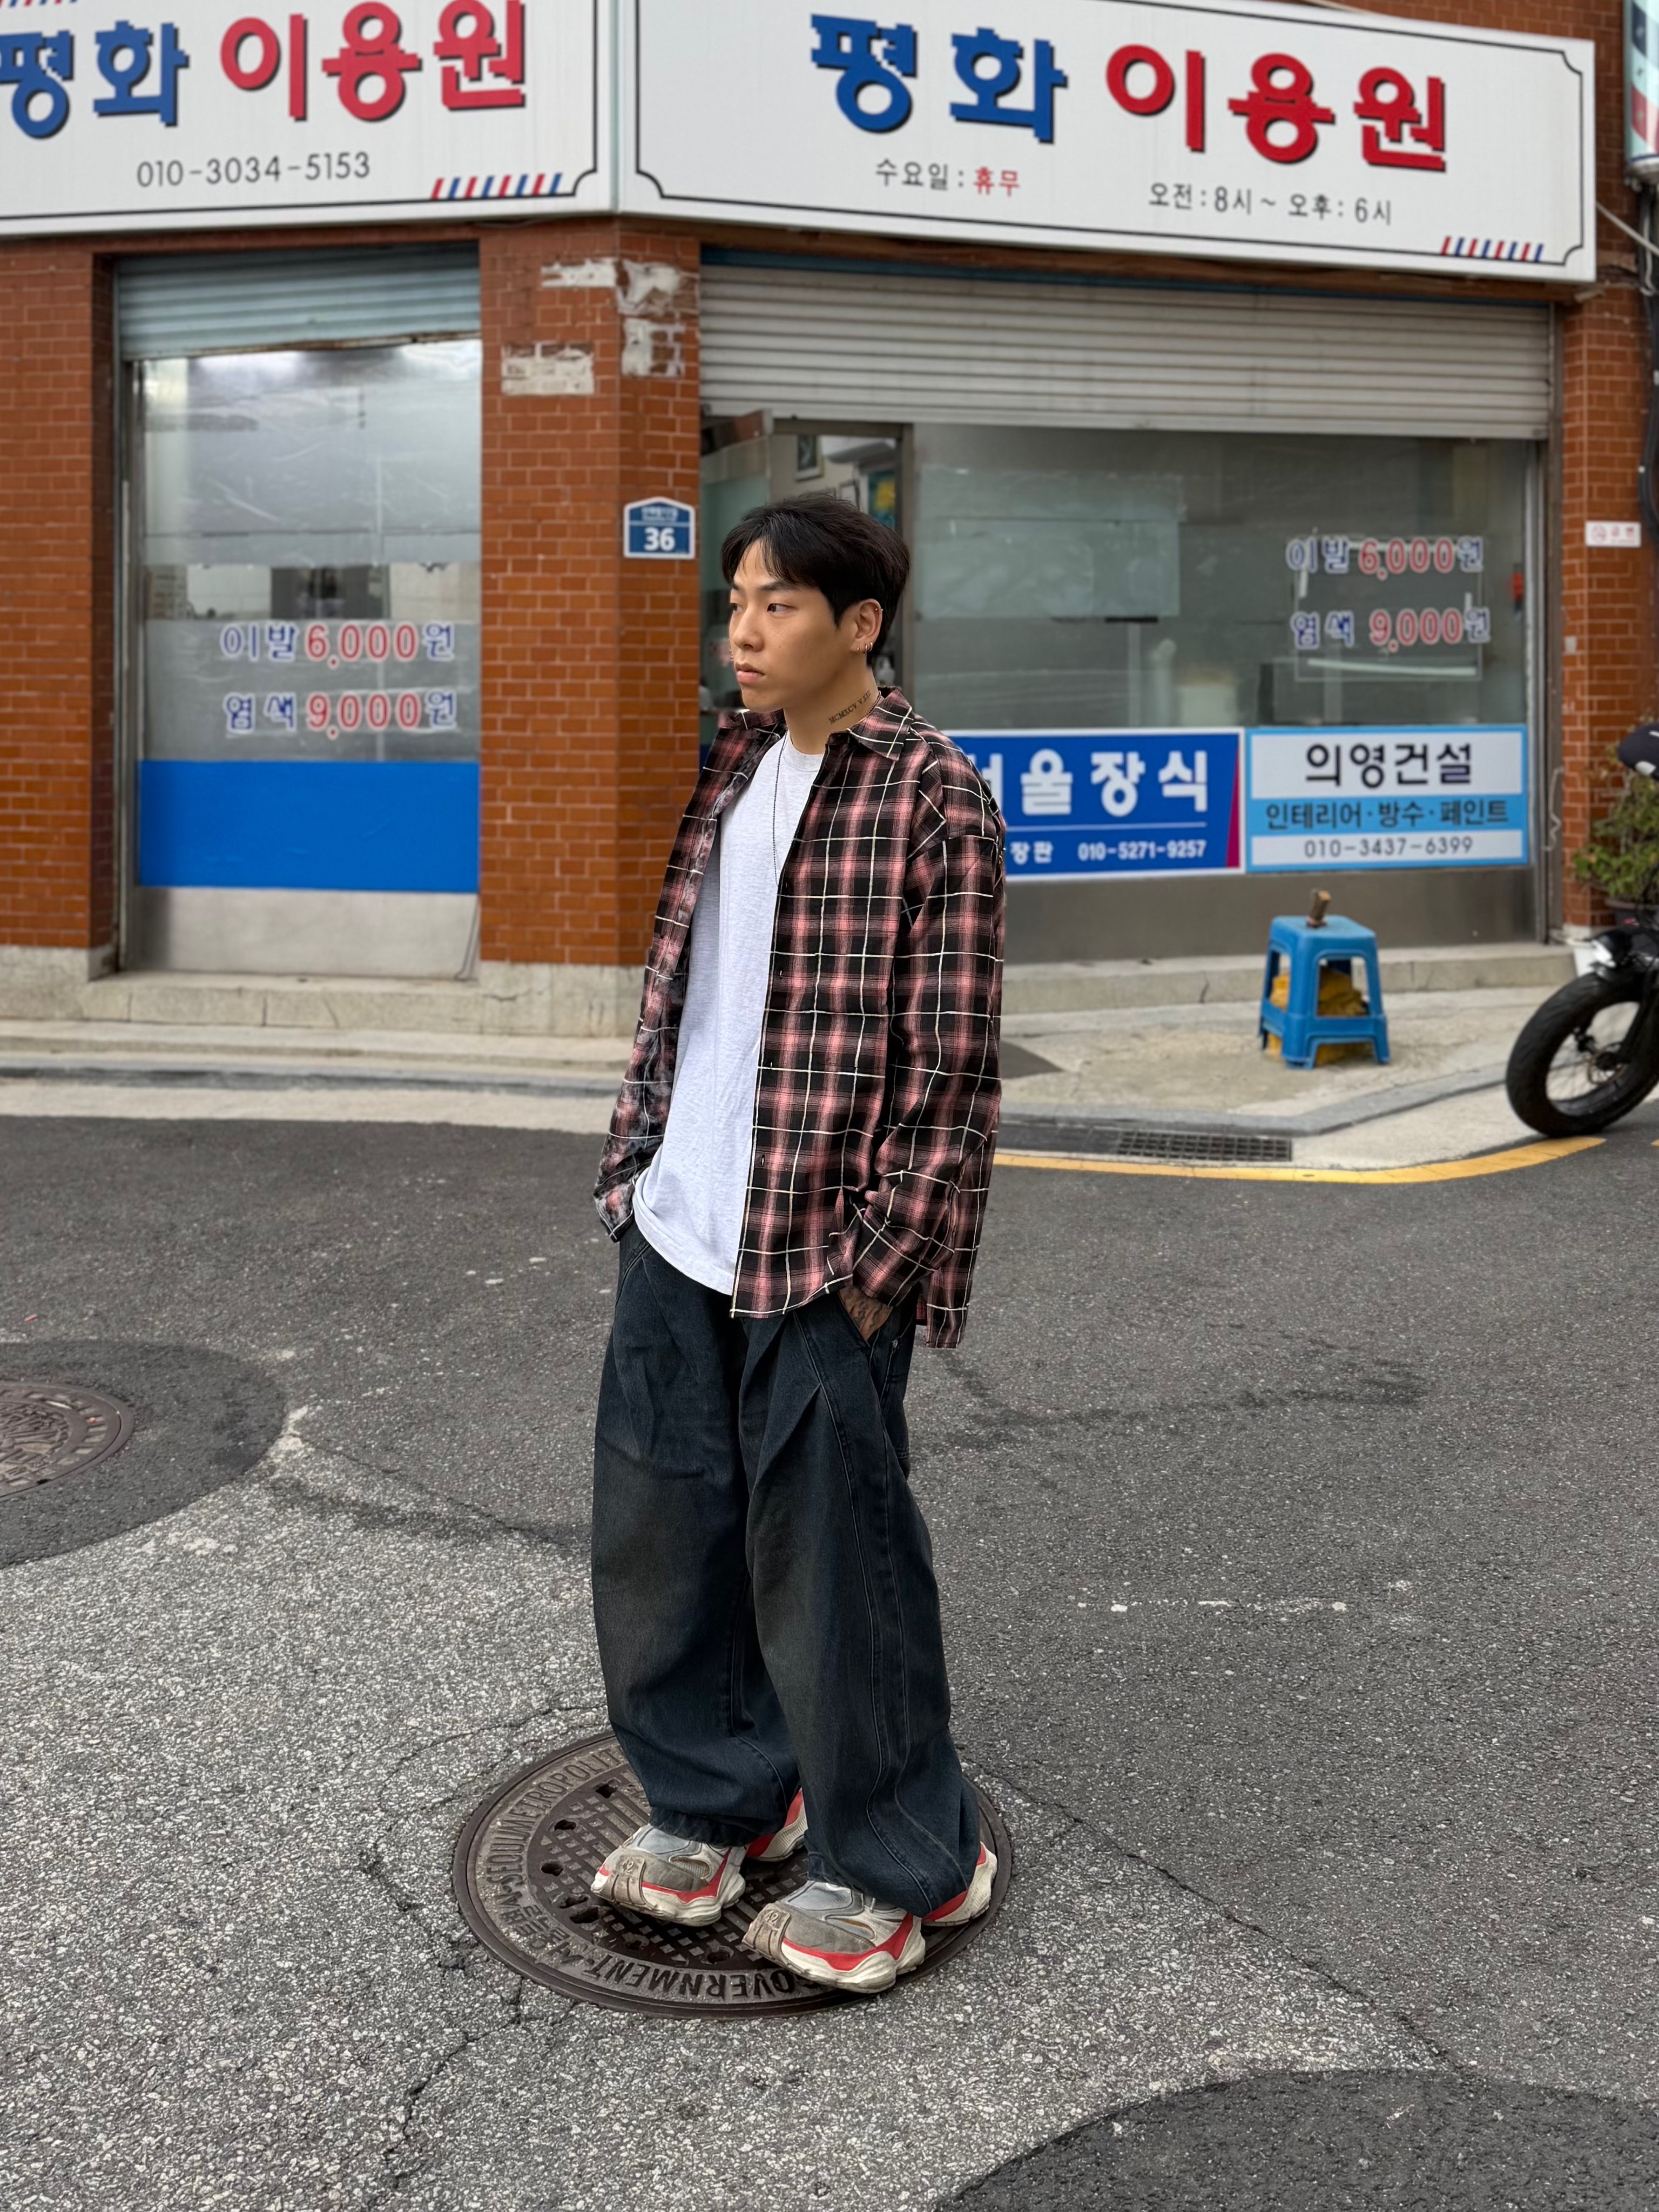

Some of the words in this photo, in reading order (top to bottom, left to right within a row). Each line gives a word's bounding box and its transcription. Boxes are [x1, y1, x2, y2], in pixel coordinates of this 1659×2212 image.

[0, 21, 190, 139] 평화
[220, 0, 525, 122] 이용원
[811, 14, 1068, 144] 평화
[1106, 44, 1445, 172] 이용원
[137, 151, 370, 187] 010-3034-5153
[644, 527, 676, 551] 36
[1287, 537, 1349, 572] 이발
[222, 623, 298, 661] 이발
[224, 693, 296, 731] 염색
[1305, 743, 1472, 789] 의영건설
[1078, 839, 1207, 861] 010-5271-9257
[1304, 836, 1473, 858] 010-3437-6399
